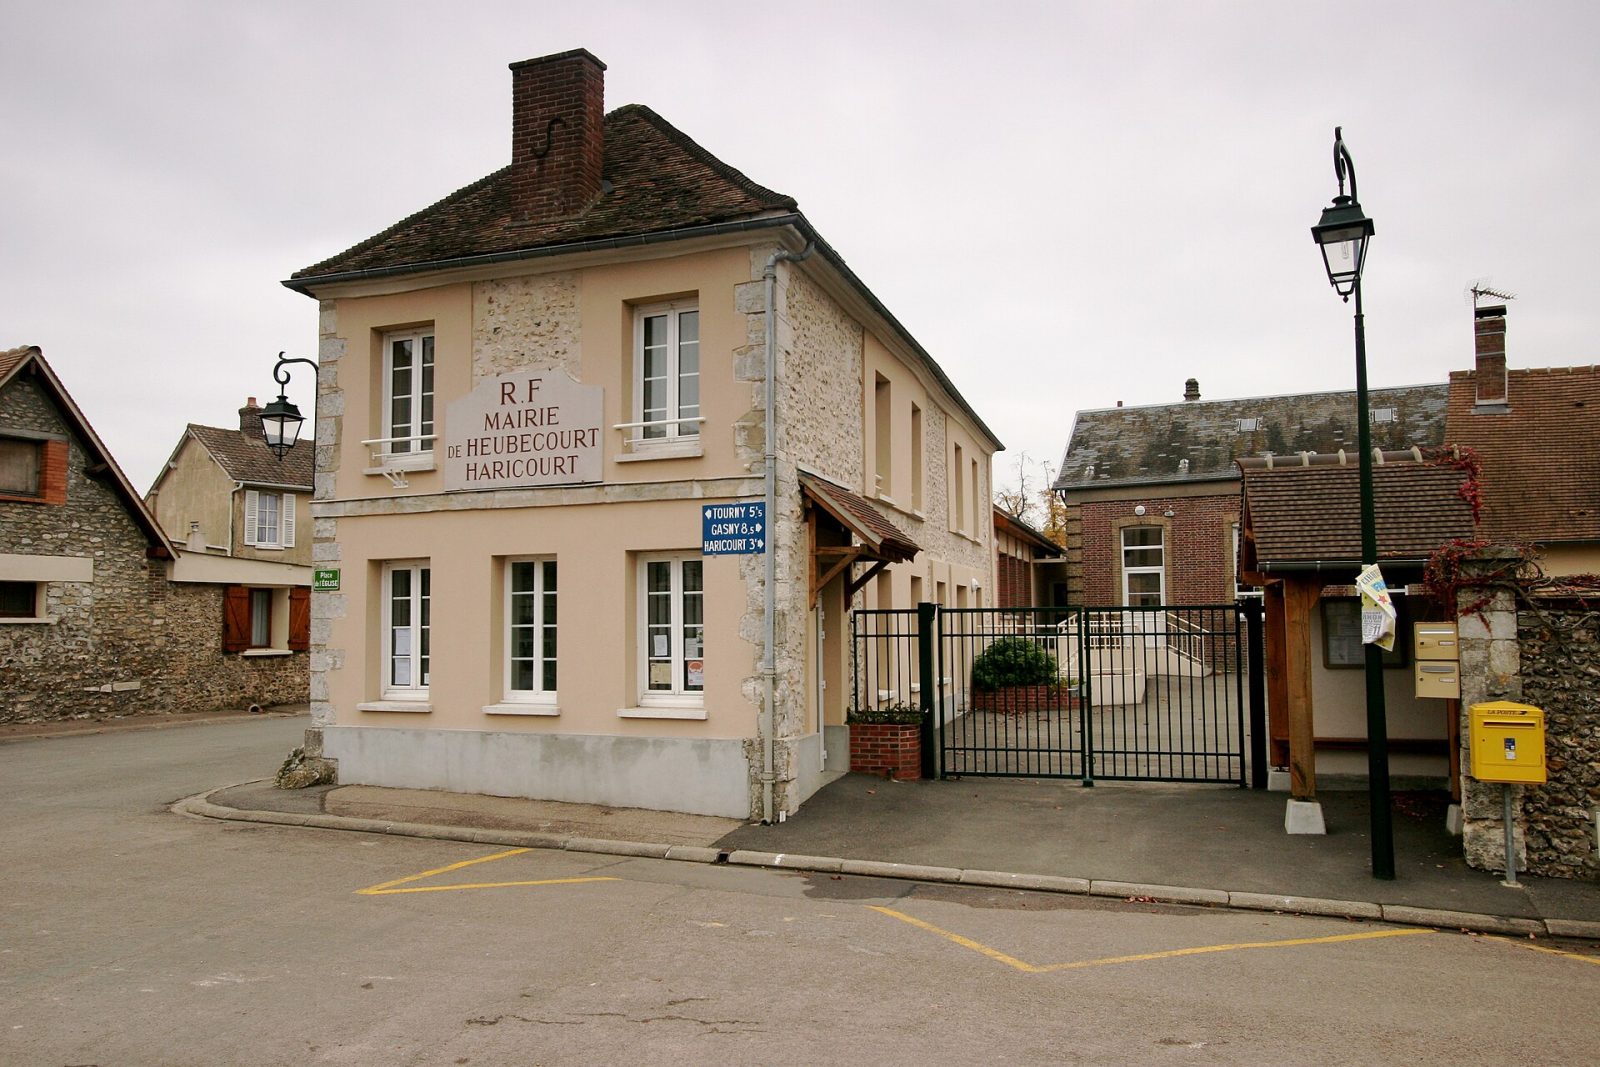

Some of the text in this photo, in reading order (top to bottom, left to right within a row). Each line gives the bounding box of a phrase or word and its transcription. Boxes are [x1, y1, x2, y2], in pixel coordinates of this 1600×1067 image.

[484, 406, 560, 431] MAIRIE
[447, 428, 600, 459] DE HEUBECOURT
[466, 455, 579, 481] HARICOURT
[712, 506, 746, 520] TOURNY
[711, 523, 740, 536] GASNY
[704, 538, 747, 552] HARICOURT
